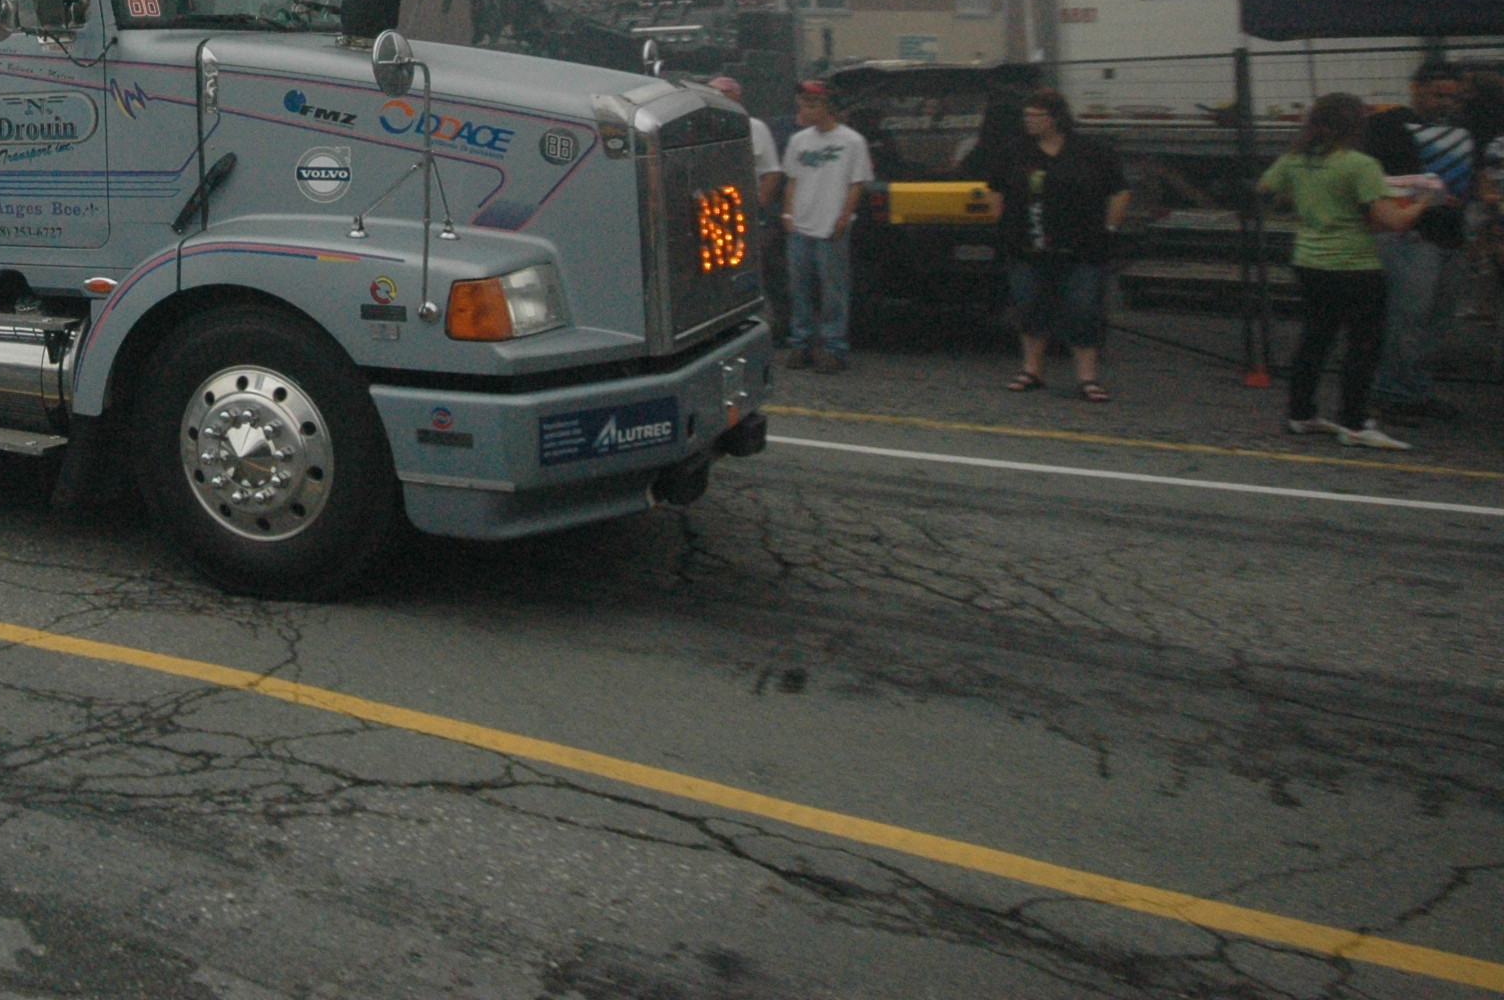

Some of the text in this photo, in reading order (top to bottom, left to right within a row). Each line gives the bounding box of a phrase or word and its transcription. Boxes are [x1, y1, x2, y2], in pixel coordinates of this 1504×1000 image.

[25, 98, 53, 116] N.
[299, 105, 358, 126] FMZ
[546, 133, 573, 161] 88
[300, 169, 348, 179] VOLVO
[592, 415, 673, 453] ALUTREC
